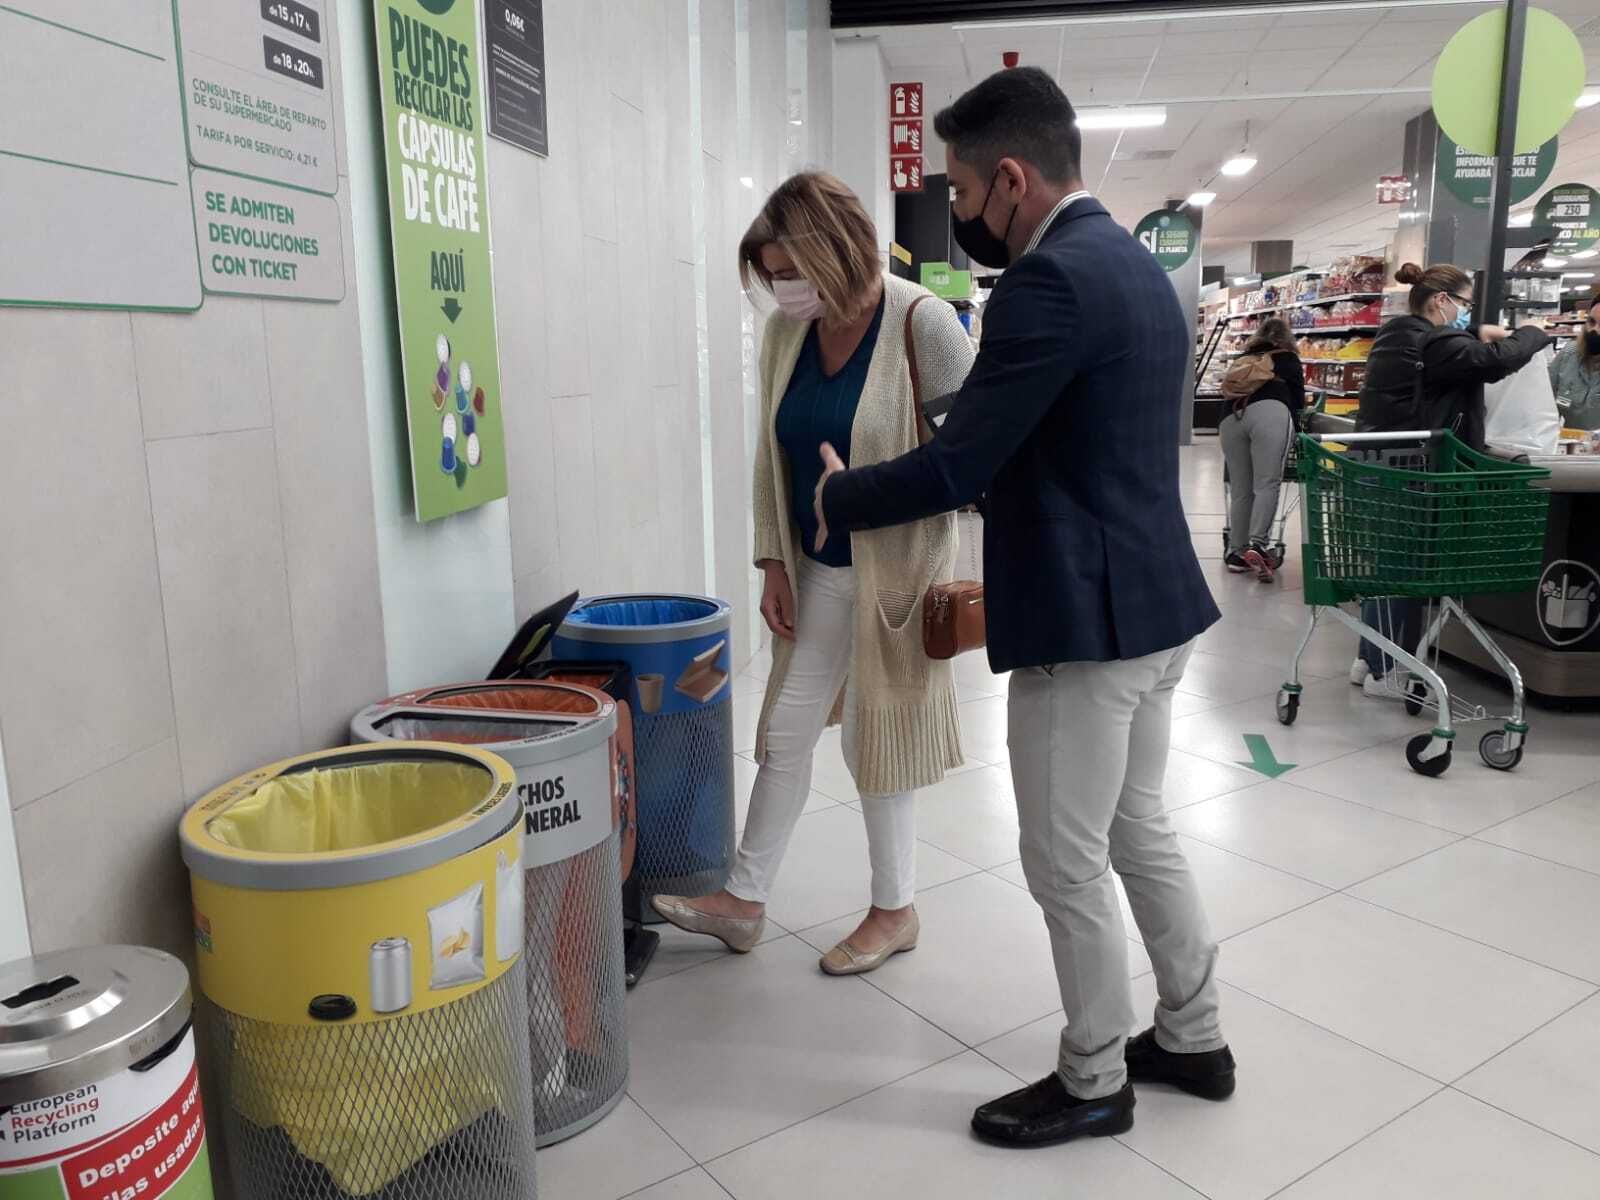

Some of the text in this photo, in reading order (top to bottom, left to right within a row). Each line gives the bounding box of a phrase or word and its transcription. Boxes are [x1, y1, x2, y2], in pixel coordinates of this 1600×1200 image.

[277, 4, 289, 22] 15
[295, 11, 305, 28] 17
[281, 53, 292, 71] 18
[388, 6, 471, 99] PUEDES
[192, 78, 326, 130] CONSULTE EL ÁREA DE REPARTO
[194, 93, 292, 132] DE SU SUPERMERCADO
[393, 70, 451, 124] RECICLAR
[453, 95, 473, 132] LAS
[196, 125, 231, 144] TARIFA
[234, 135, 252, 151] POR
[254, 141, 295, 161] SERVICIO:
[398, 107, 476, 181] CÁPSULAS
[1455, 167, 1491, 178] AYUDARÁ
[1456, 157, 1495, 166] INFORMAC
[205, 191, 295, 225] SE ADMITEN
[401, 163, 432, 224] DE
[208, 222, 319, 256] DEVOLUCIONES
[1139, 227, 1158, 253] SÍ
[212, 254, 298, 281] CON TICKET
[431, 248, 465, 292] AQUÍ
[517, 776, 565, 807] CHOS
[525, 800, 581, 835] NERAL
[10, 1084, 97, 1115] European
[11, 1097, 100, 1129] Recycling
[13, 1112, 96, 1143] Platform
[78, 1114, 179, 1188] Deposite
[154, 1114, 201, 1179] usadas
